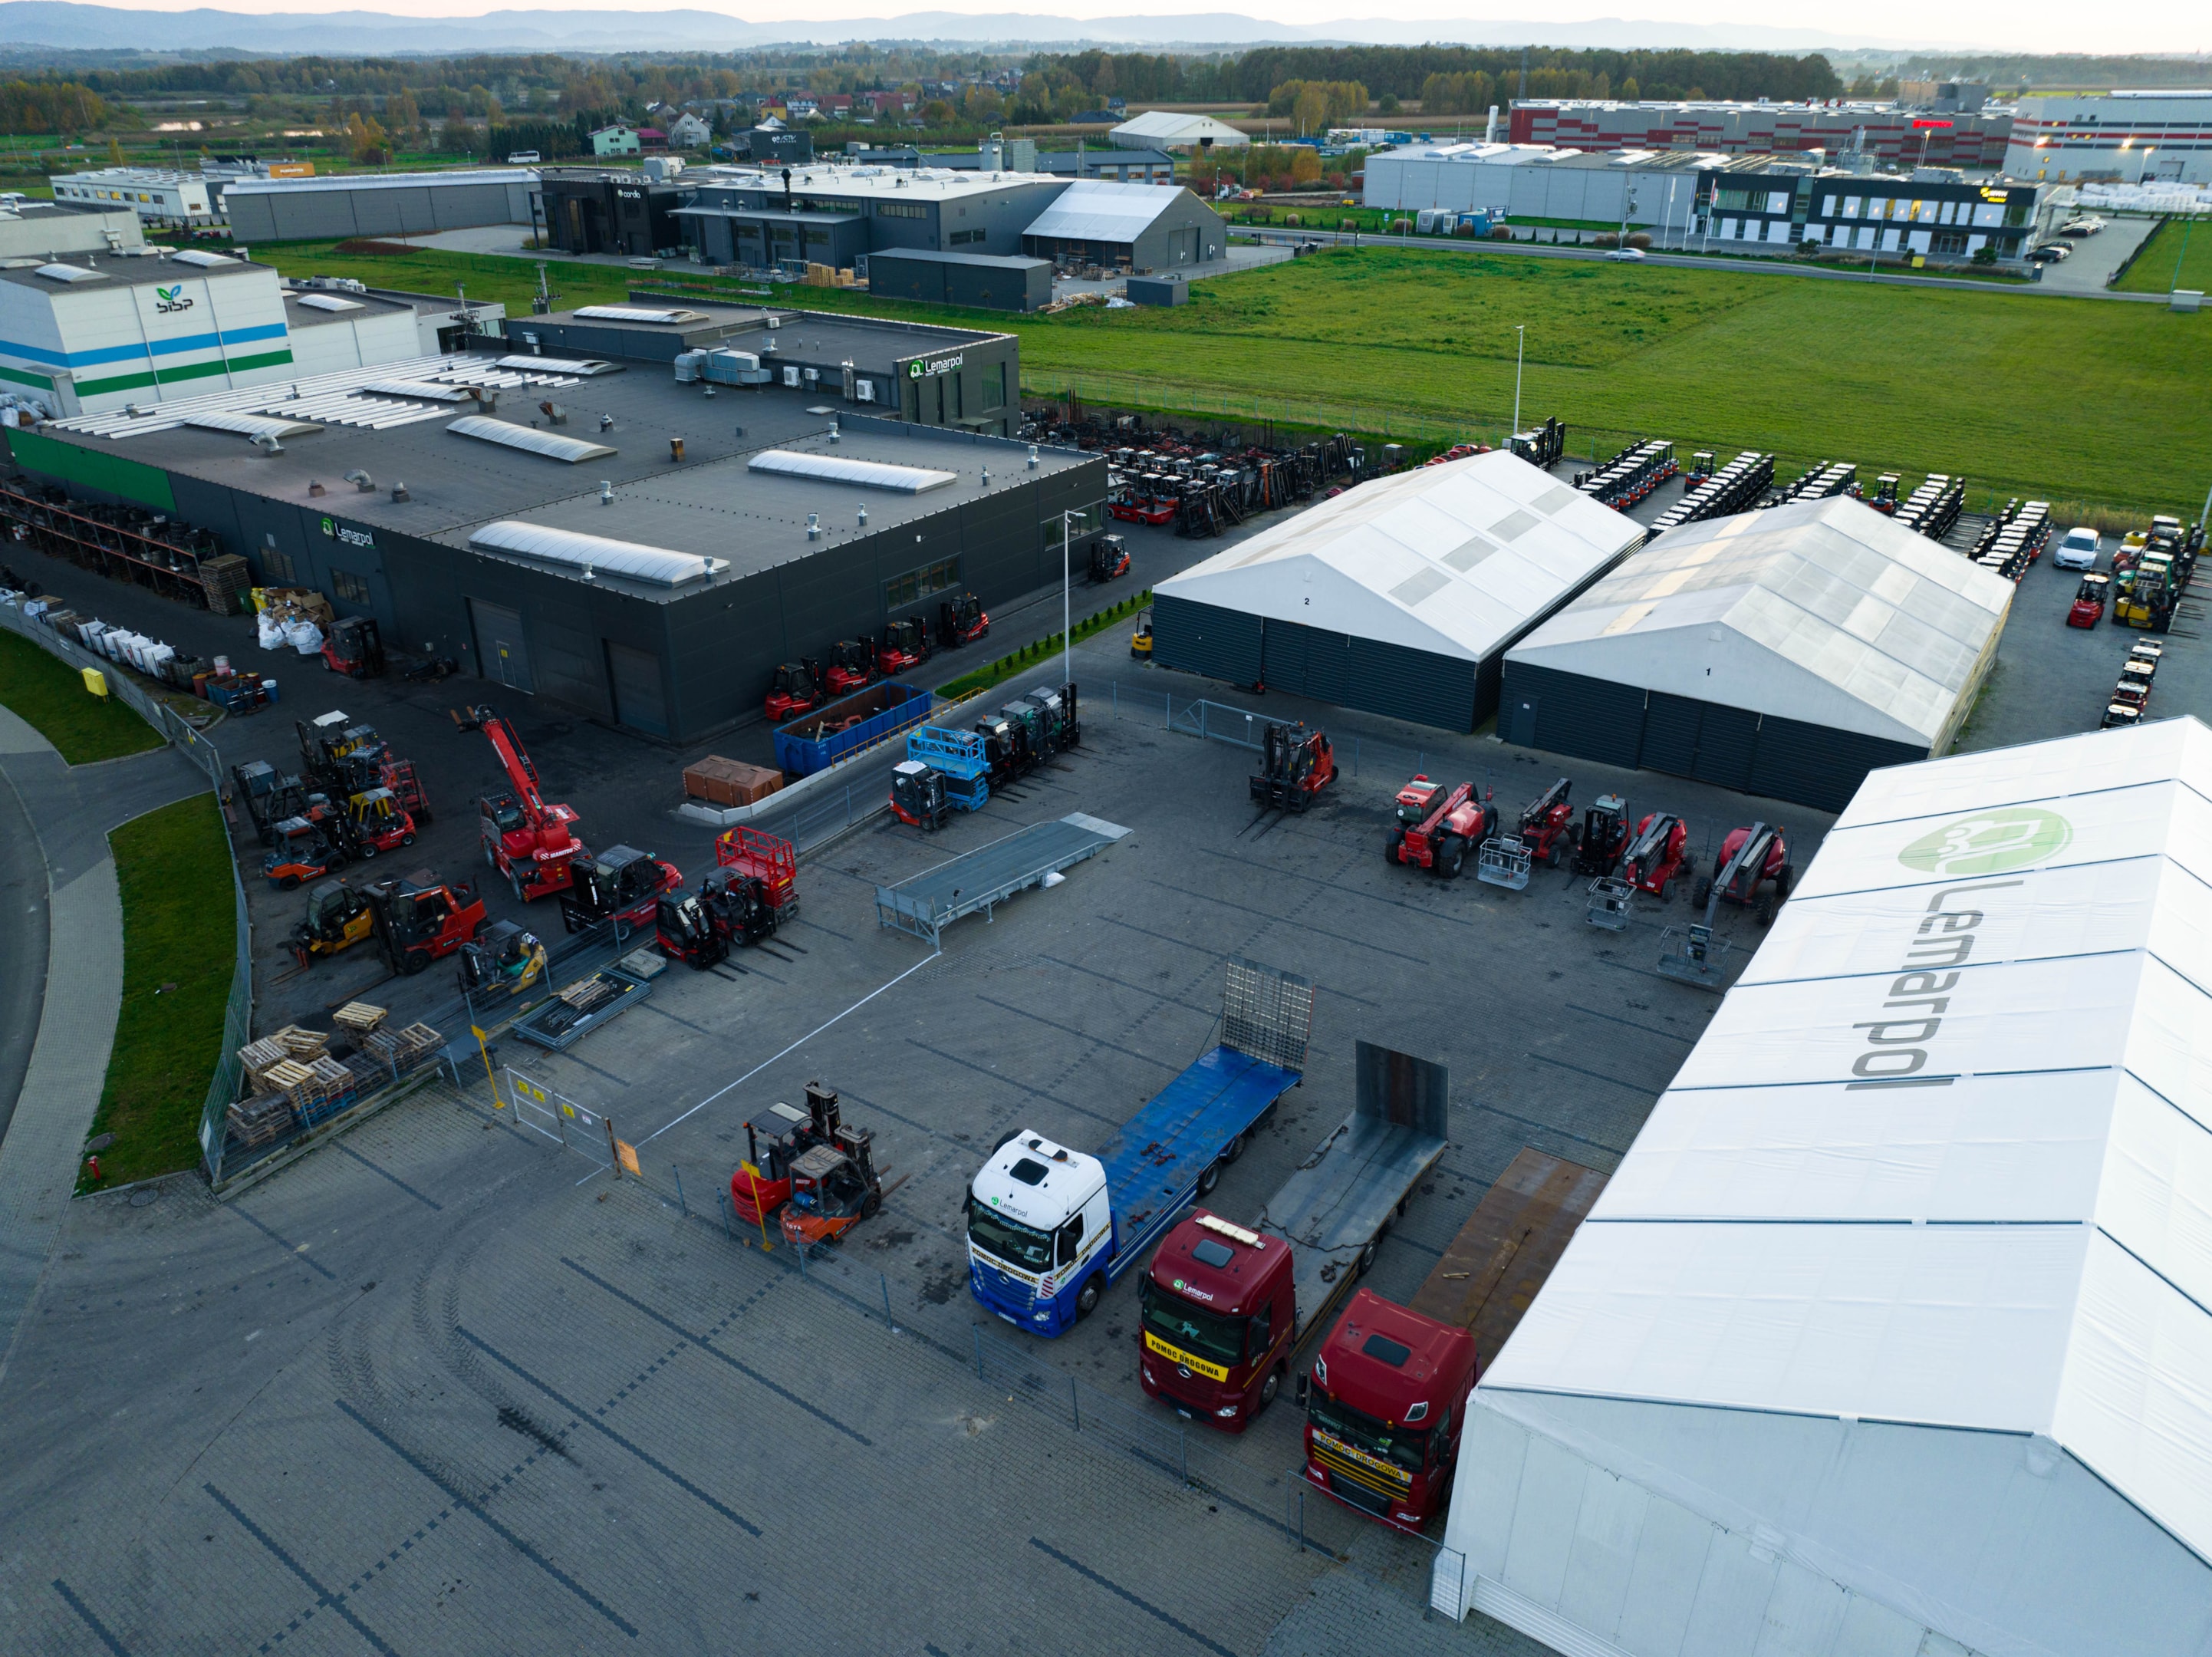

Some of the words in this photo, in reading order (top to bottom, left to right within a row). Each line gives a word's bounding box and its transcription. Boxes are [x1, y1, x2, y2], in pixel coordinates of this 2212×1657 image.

[924, 352, 963, 373] Lemarpol
[334, 522, 374, 546] Lemarpol
[1706, 667, 1711, 676] 1
[550, 847, 574, 858] MANITOU
[1845, 880, 2024, 1091] Lemarpol
[999, 1198, 1029, 1219] Lemarpol
[1081, 1223, 1110, 1256] DROGOWA
[972, 1247, 997, 1266] POMOC
[997, 1262, 1037, 1284] DROGOWA
[1183, 1282, 1214, 1302] Lemarpol
[1151, 1339, 1177, 1359] POMOC
[1179, 1353, 1220, 1377] DROGOWA
[1320, 1435, 1351, 1455] POMOC
[1355, 1451, 1403, 1479] DROGOWA
